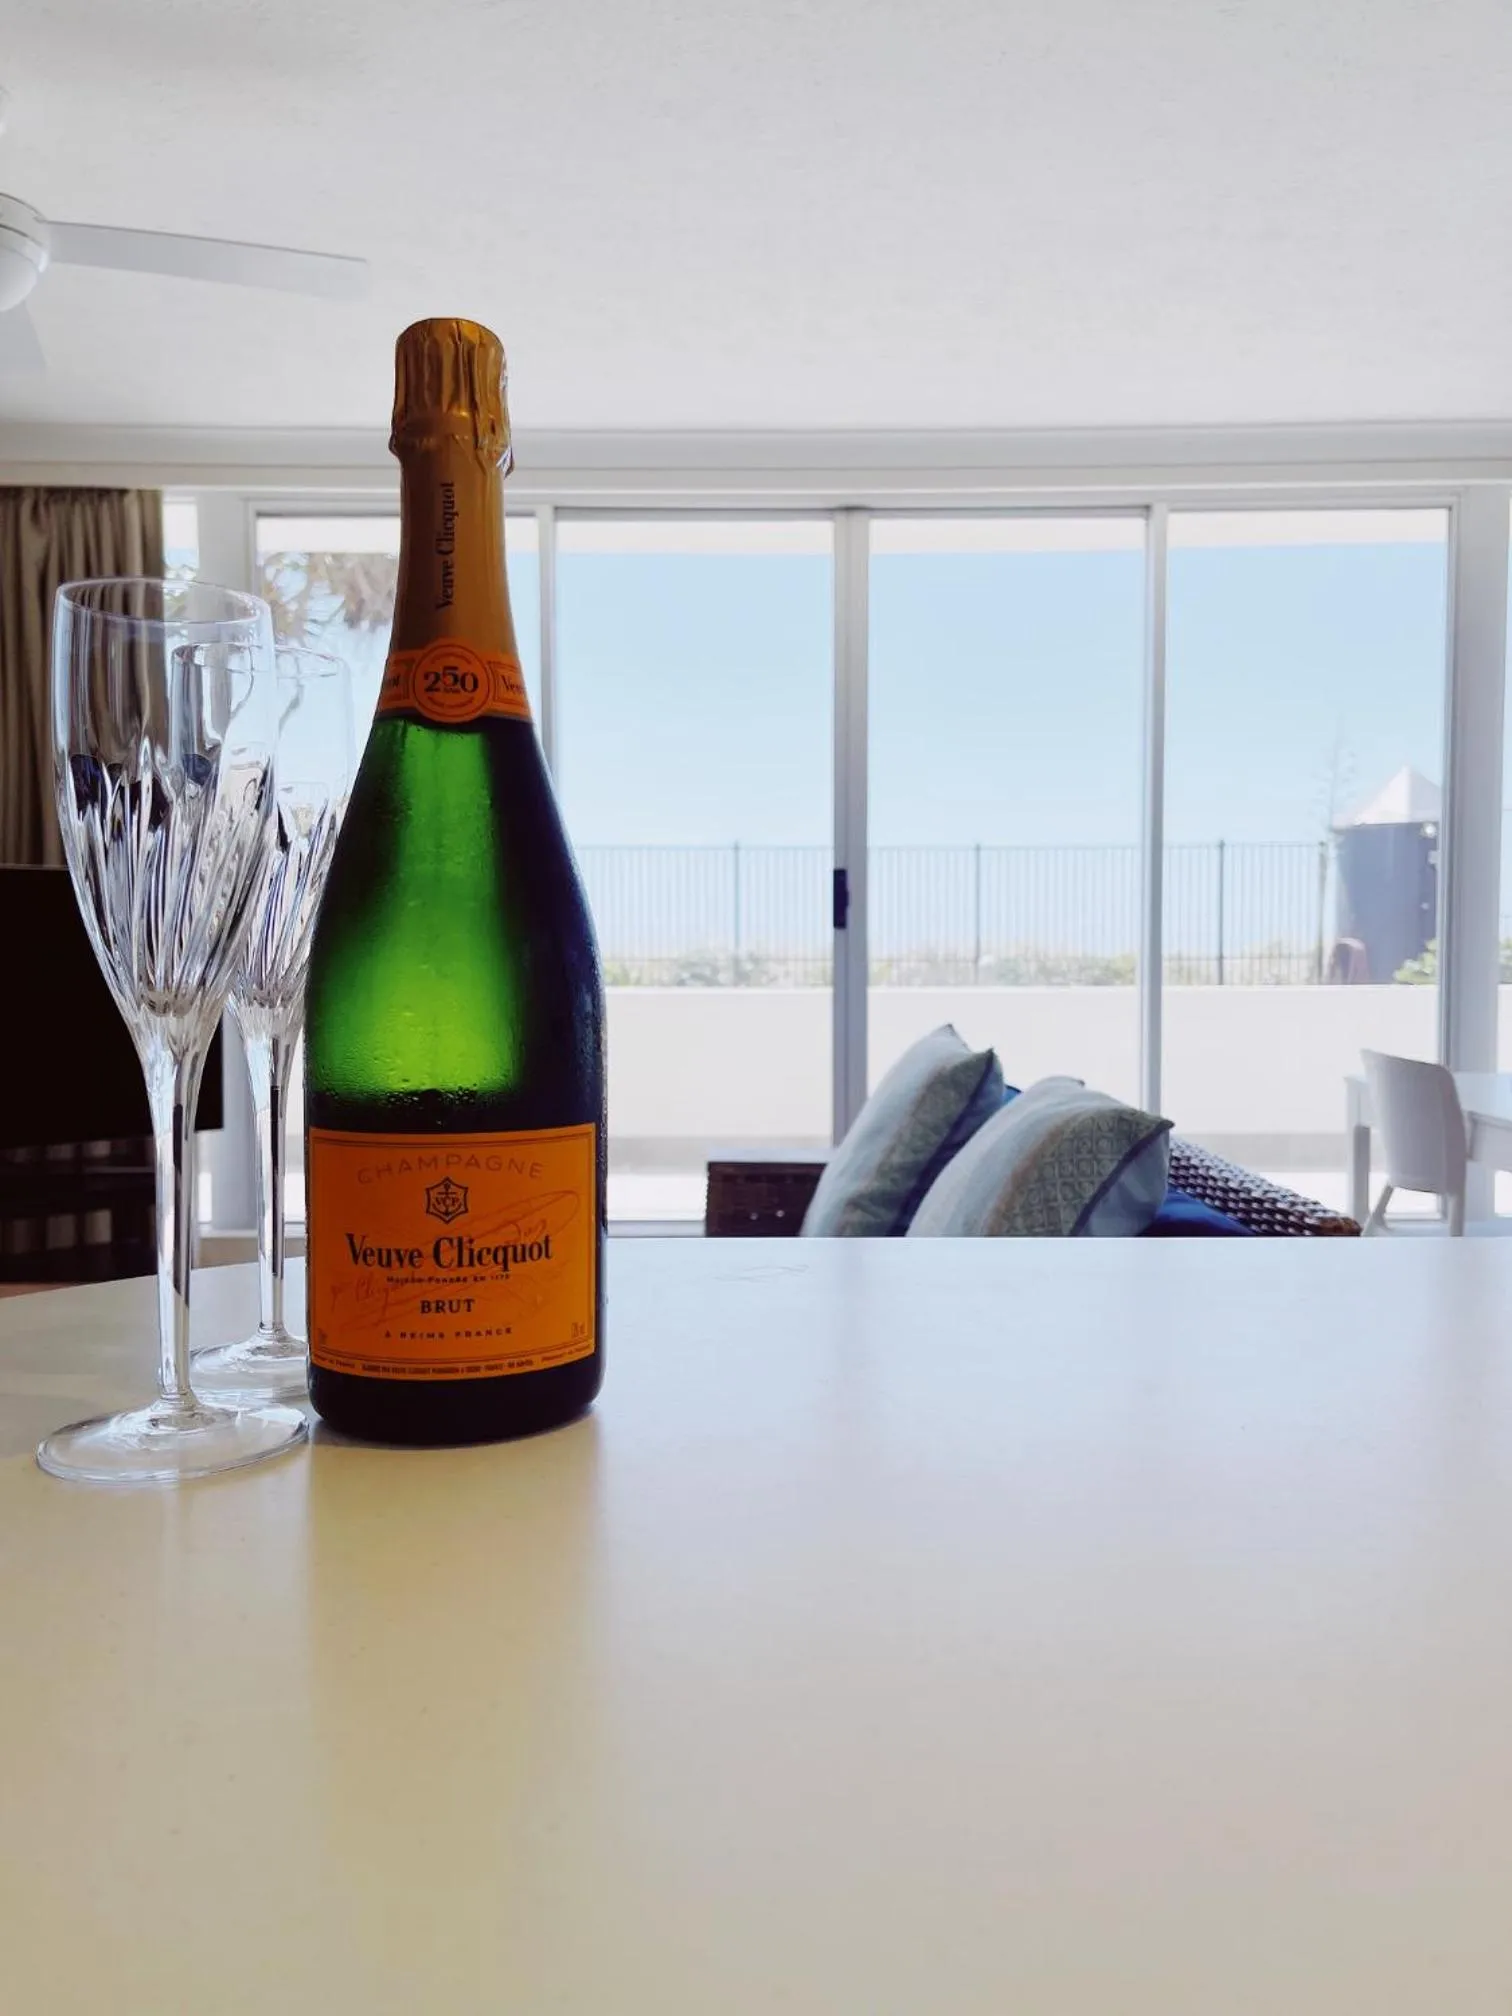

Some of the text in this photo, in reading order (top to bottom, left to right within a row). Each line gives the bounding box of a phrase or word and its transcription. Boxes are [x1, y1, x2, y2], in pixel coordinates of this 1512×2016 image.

[435, 482, 459, 611] Veuve Clicquot
[423, 665, 479, 693] 250
[357, 1153, 544, 1184] CHAMPAGNE
[345, 1233, 553, 1272] Veuve Clicquot
[419, 1298, 475, 1314] BRUT
